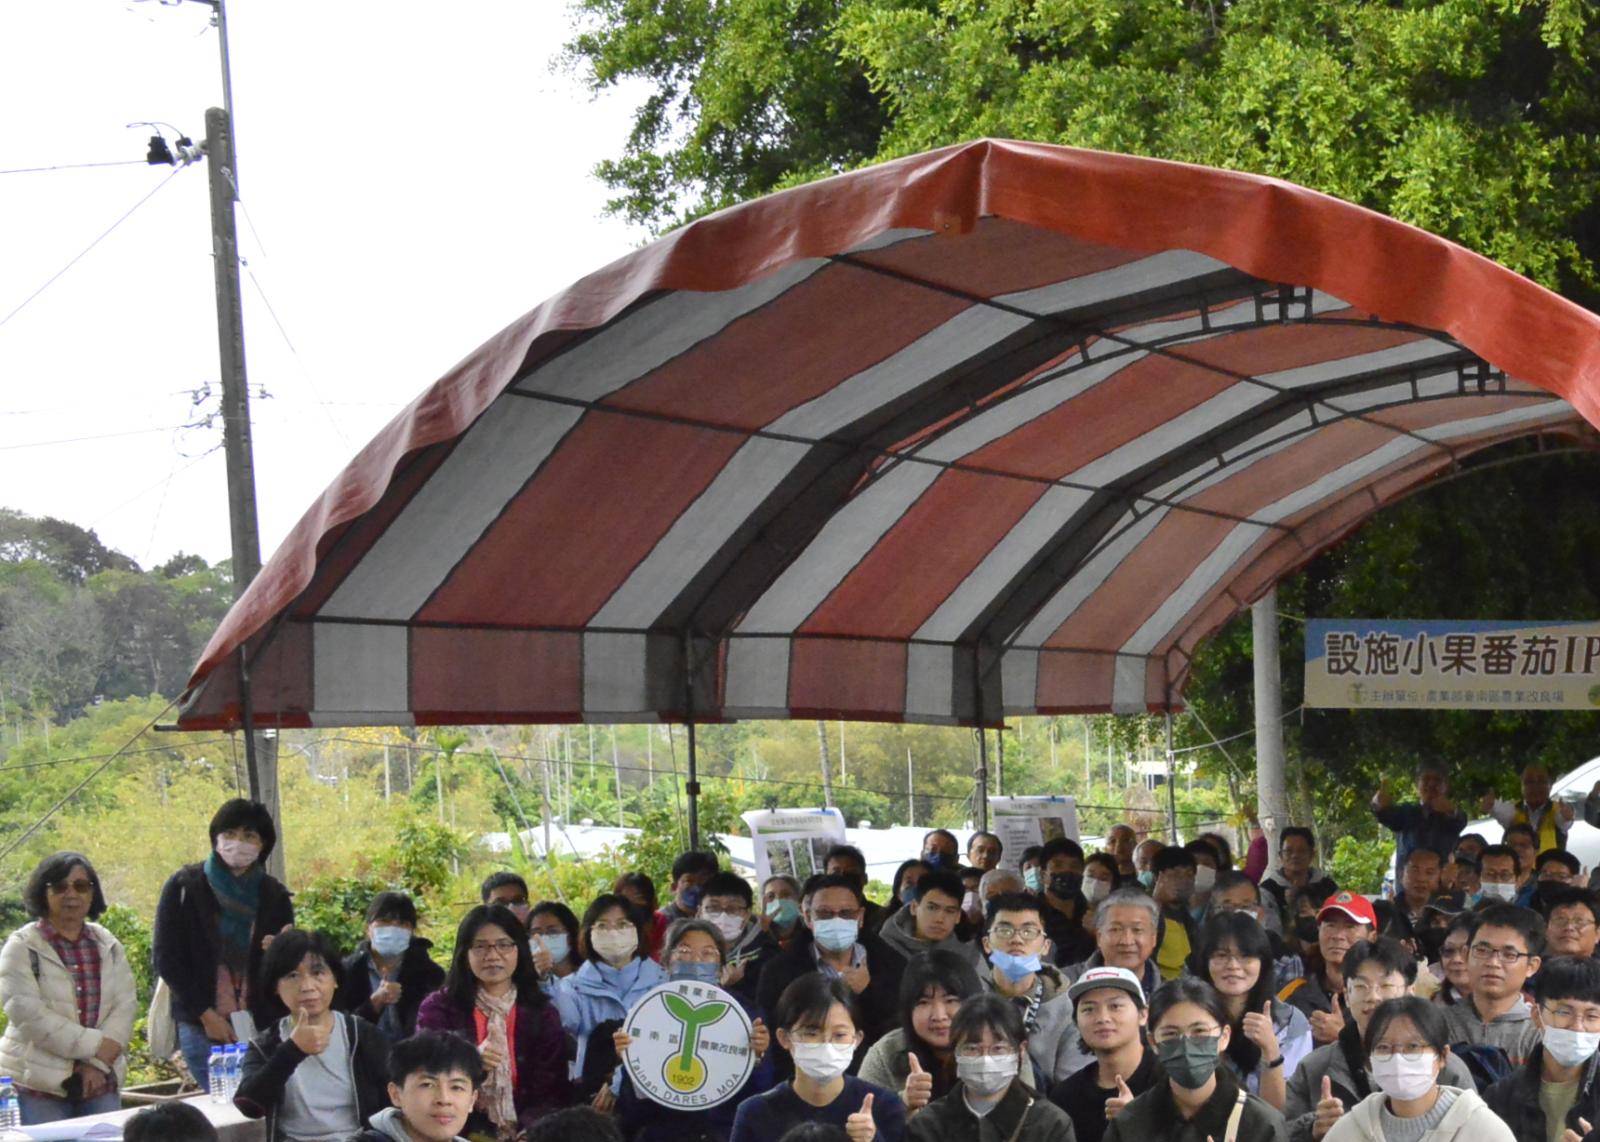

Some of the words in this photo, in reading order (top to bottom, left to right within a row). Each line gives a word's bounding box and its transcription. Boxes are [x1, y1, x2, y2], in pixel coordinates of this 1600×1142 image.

[679, 985, 717, 1000] 農業部
[630, 1057, 659, 1094] Tainan
[717, 1072, 741, 1096] MOA
[671, 1073, 695, 1086] 1902
